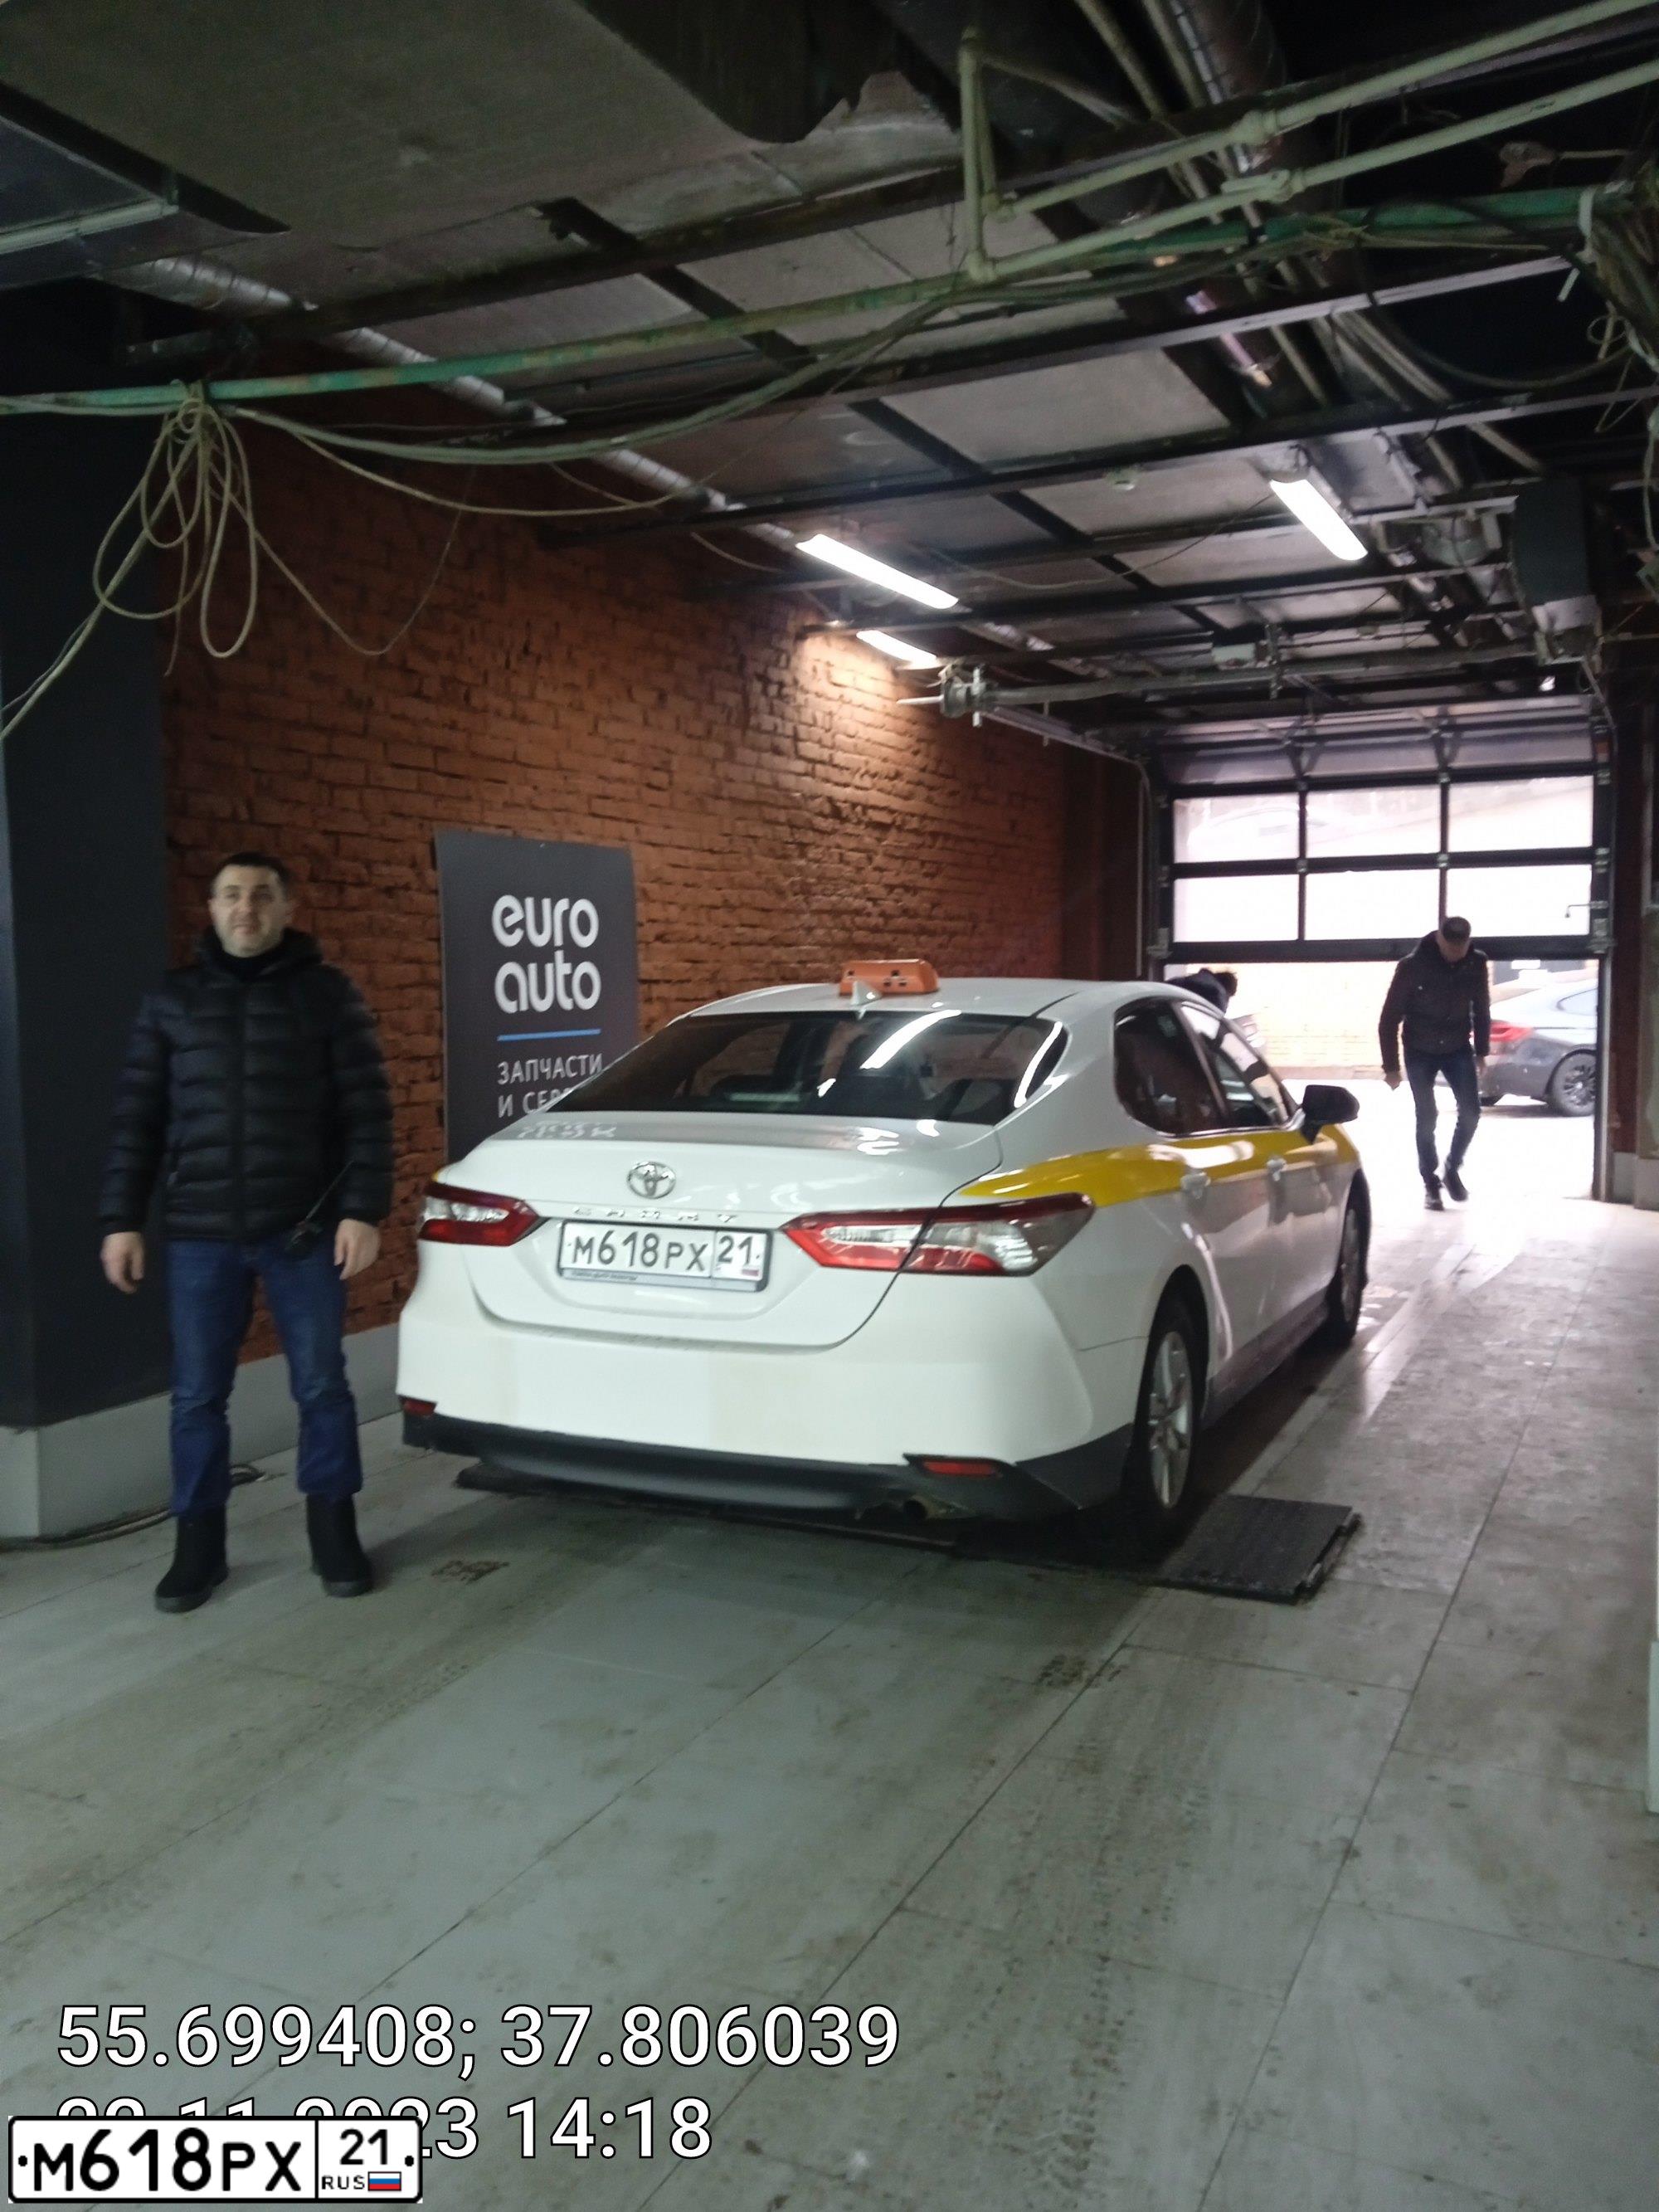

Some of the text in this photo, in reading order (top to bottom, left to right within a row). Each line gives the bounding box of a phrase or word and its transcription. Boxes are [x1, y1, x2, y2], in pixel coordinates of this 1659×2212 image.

[492, 894, 599, 948] euro
[494, 950, 601, 1014] auto
[498, 1053, 603, 1085] ЗАПЧАСТИ
[499, 1094, 513, 1118] И
[572, 1230, 754, 1272] М618РХ 21
